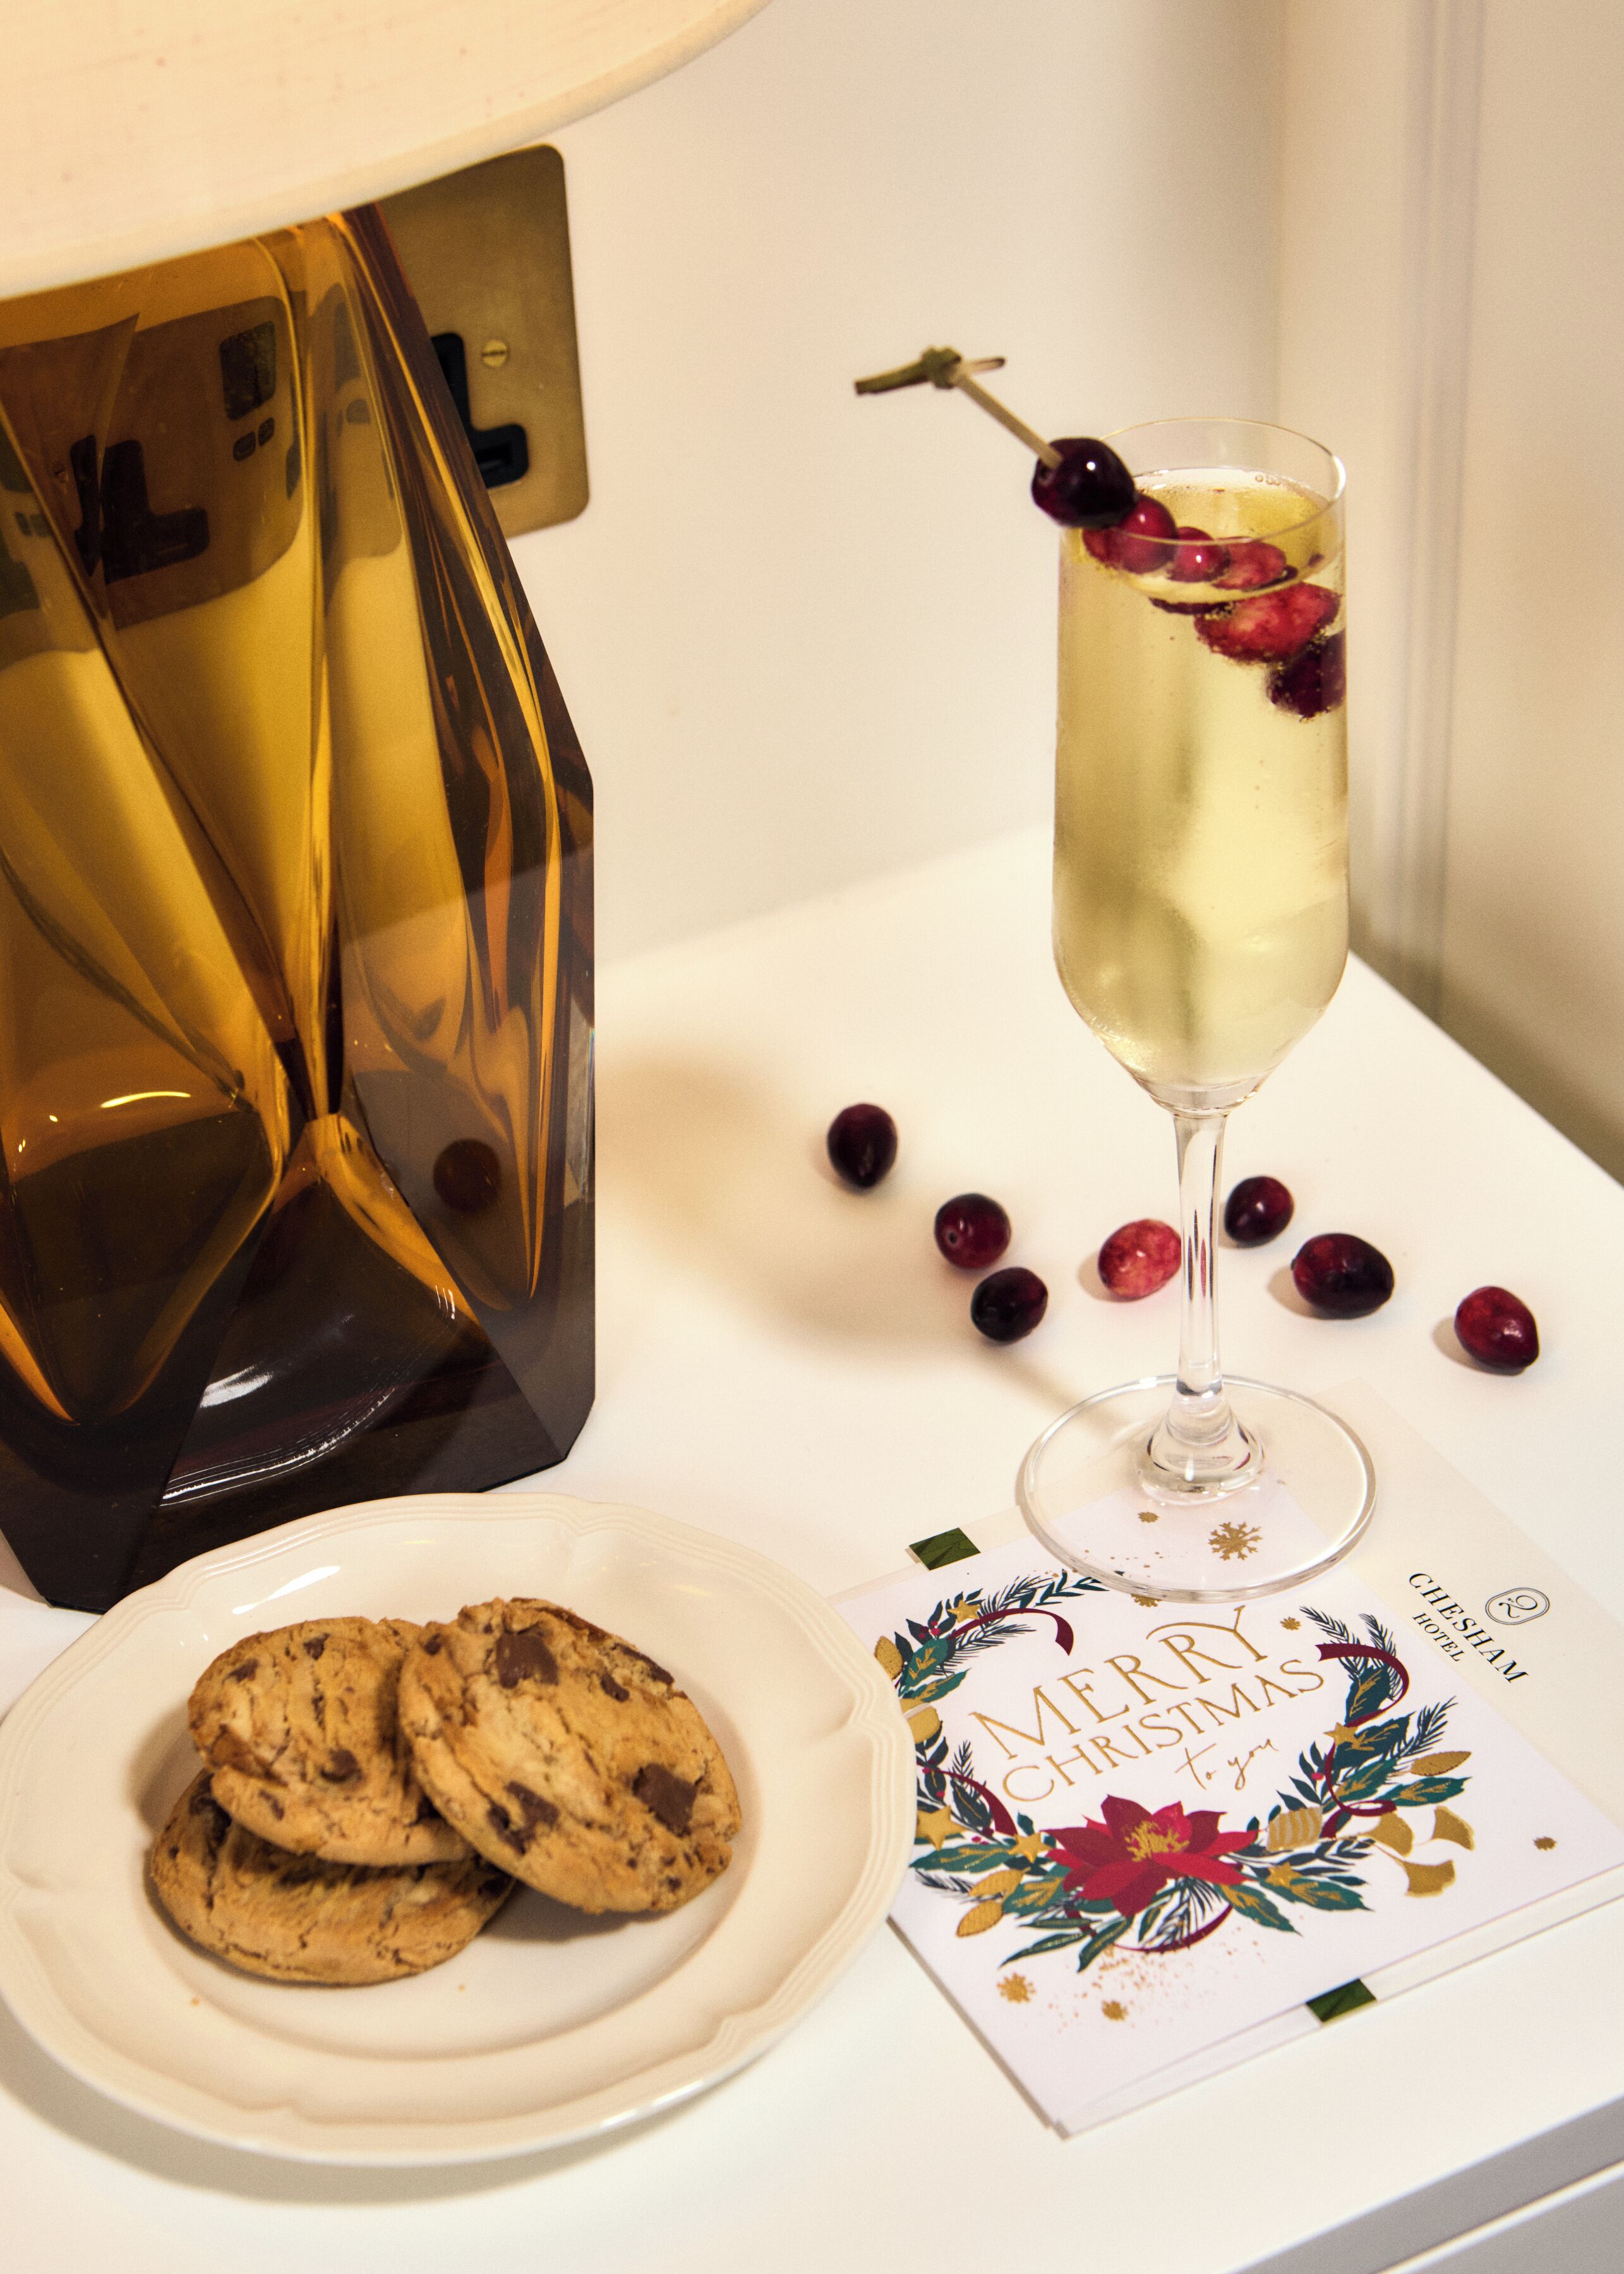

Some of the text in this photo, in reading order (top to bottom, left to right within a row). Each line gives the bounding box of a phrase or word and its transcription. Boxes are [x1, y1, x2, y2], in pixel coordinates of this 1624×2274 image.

[968, 1605, 1268, 1760] MERRY
[1409, 1572, 1529, 1683] CHESHAM
[1412, 1612, 1465, 1662] HOTEL
[1002, 1659, 1324, 1802] CHRISTMAS
[1175, 1738, 1280, 1791] to you
